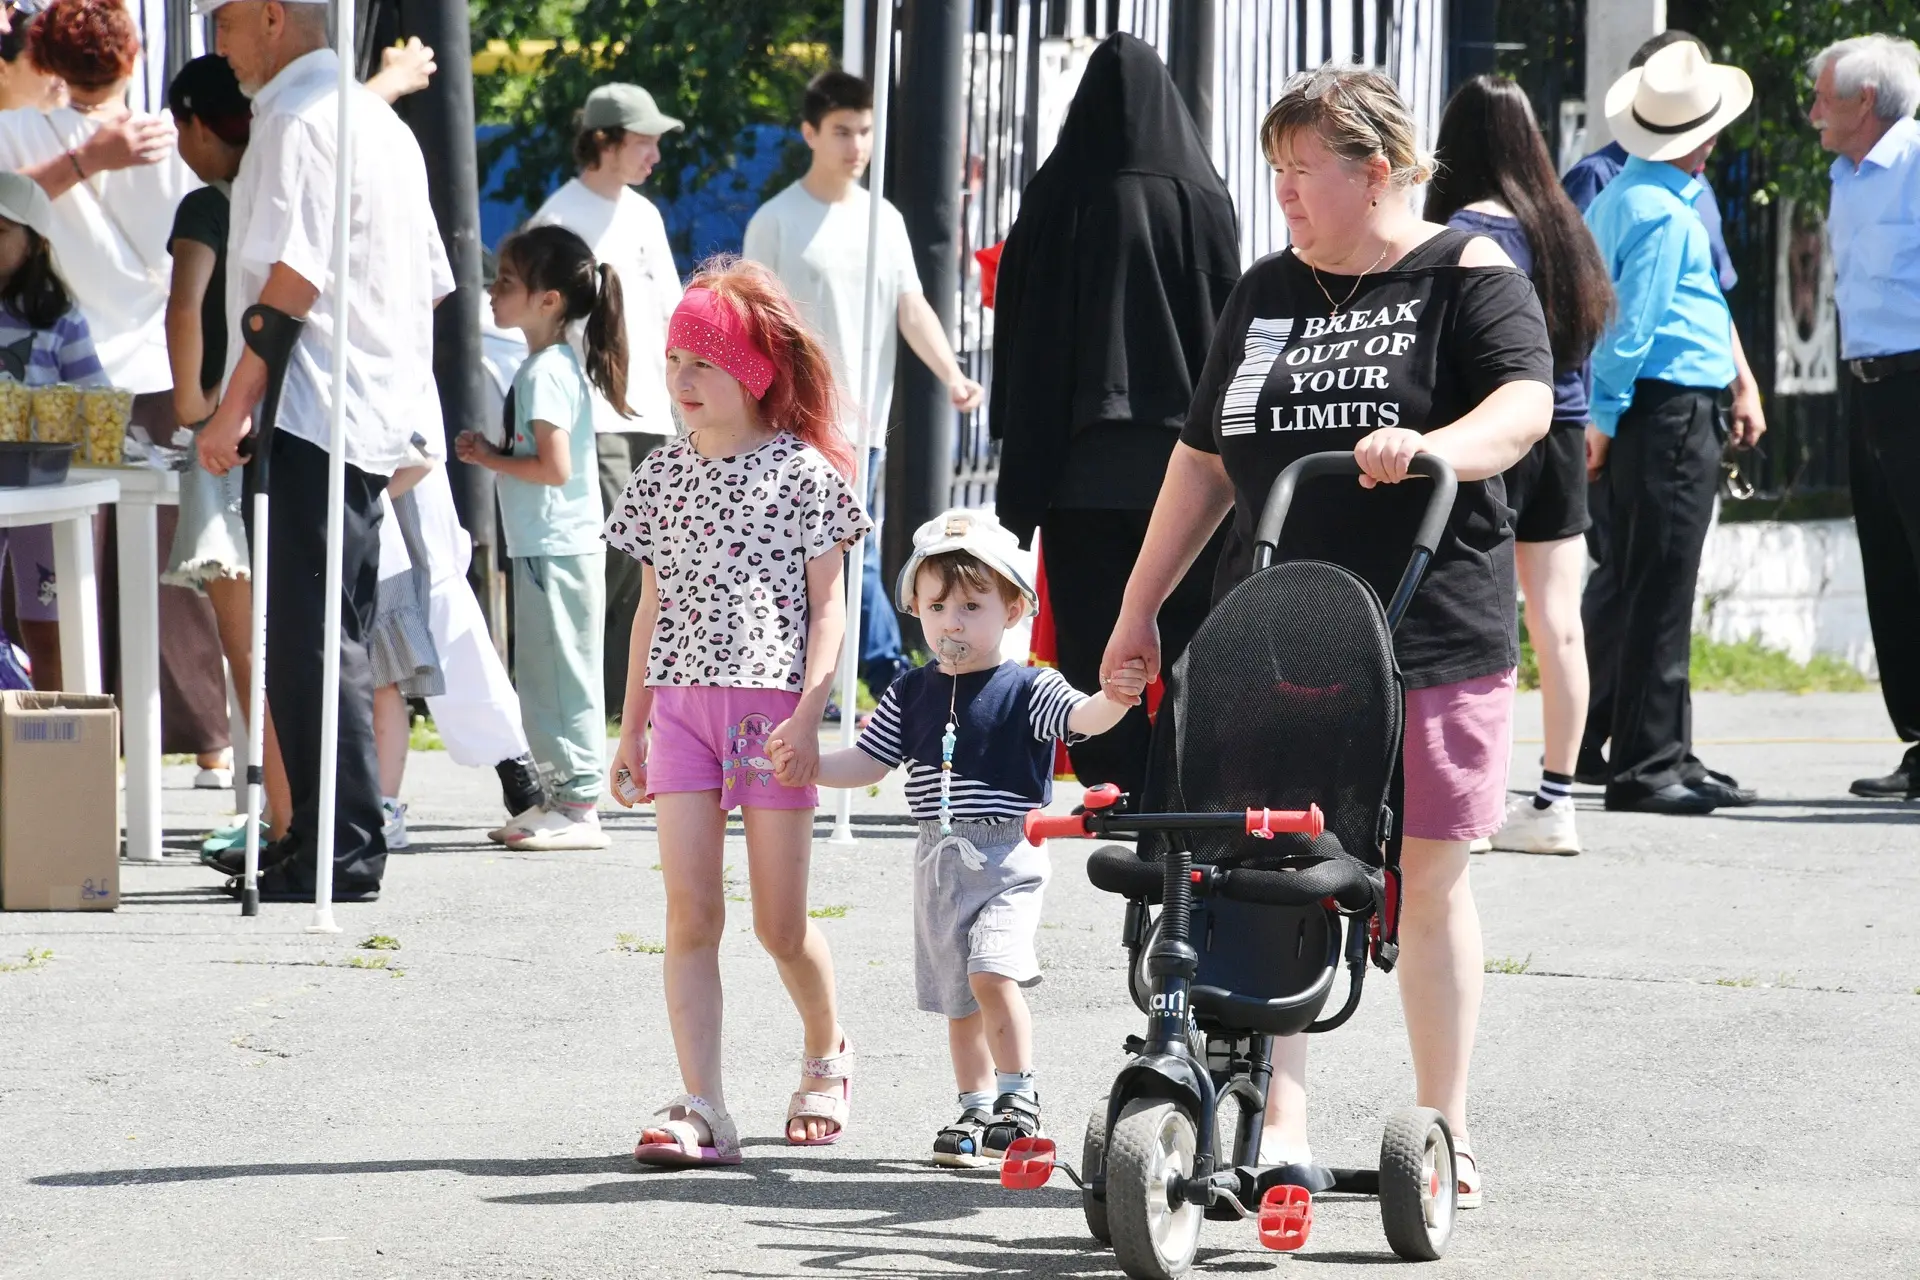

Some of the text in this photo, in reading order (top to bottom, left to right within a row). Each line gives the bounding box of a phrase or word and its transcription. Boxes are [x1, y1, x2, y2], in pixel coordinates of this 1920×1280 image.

[1300, 299, 1421, 339] BREAK
[1286, 332, 1416, 366] OUT OF
[1290, 366, 1389, 394] YOUR
[1270, 402, 1400, 432] LIMITS
[727, 720, 774, 740] HINK
[733, 756, 749, 769] BE
